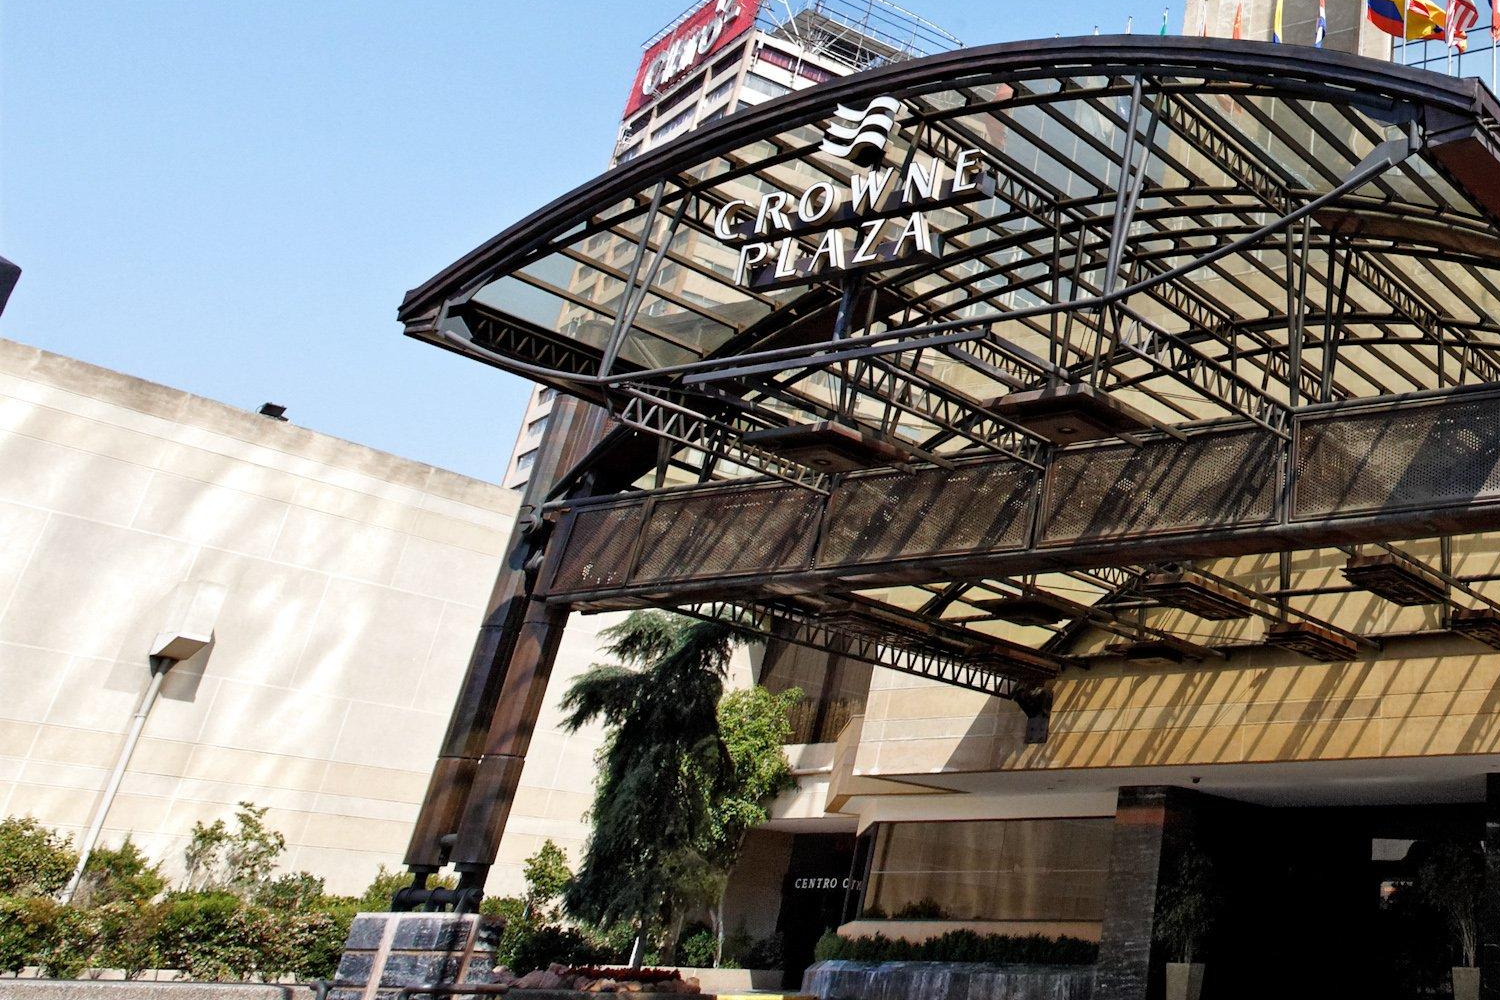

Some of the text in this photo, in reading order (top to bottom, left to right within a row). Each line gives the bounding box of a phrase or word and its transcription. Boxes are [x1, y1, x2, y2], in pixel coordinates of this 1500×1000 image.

[714, 148, 988, 241] CROWNE
[734, 211, 934, 287] PLAZA
[794, 877, 838, 889] CENTRO
